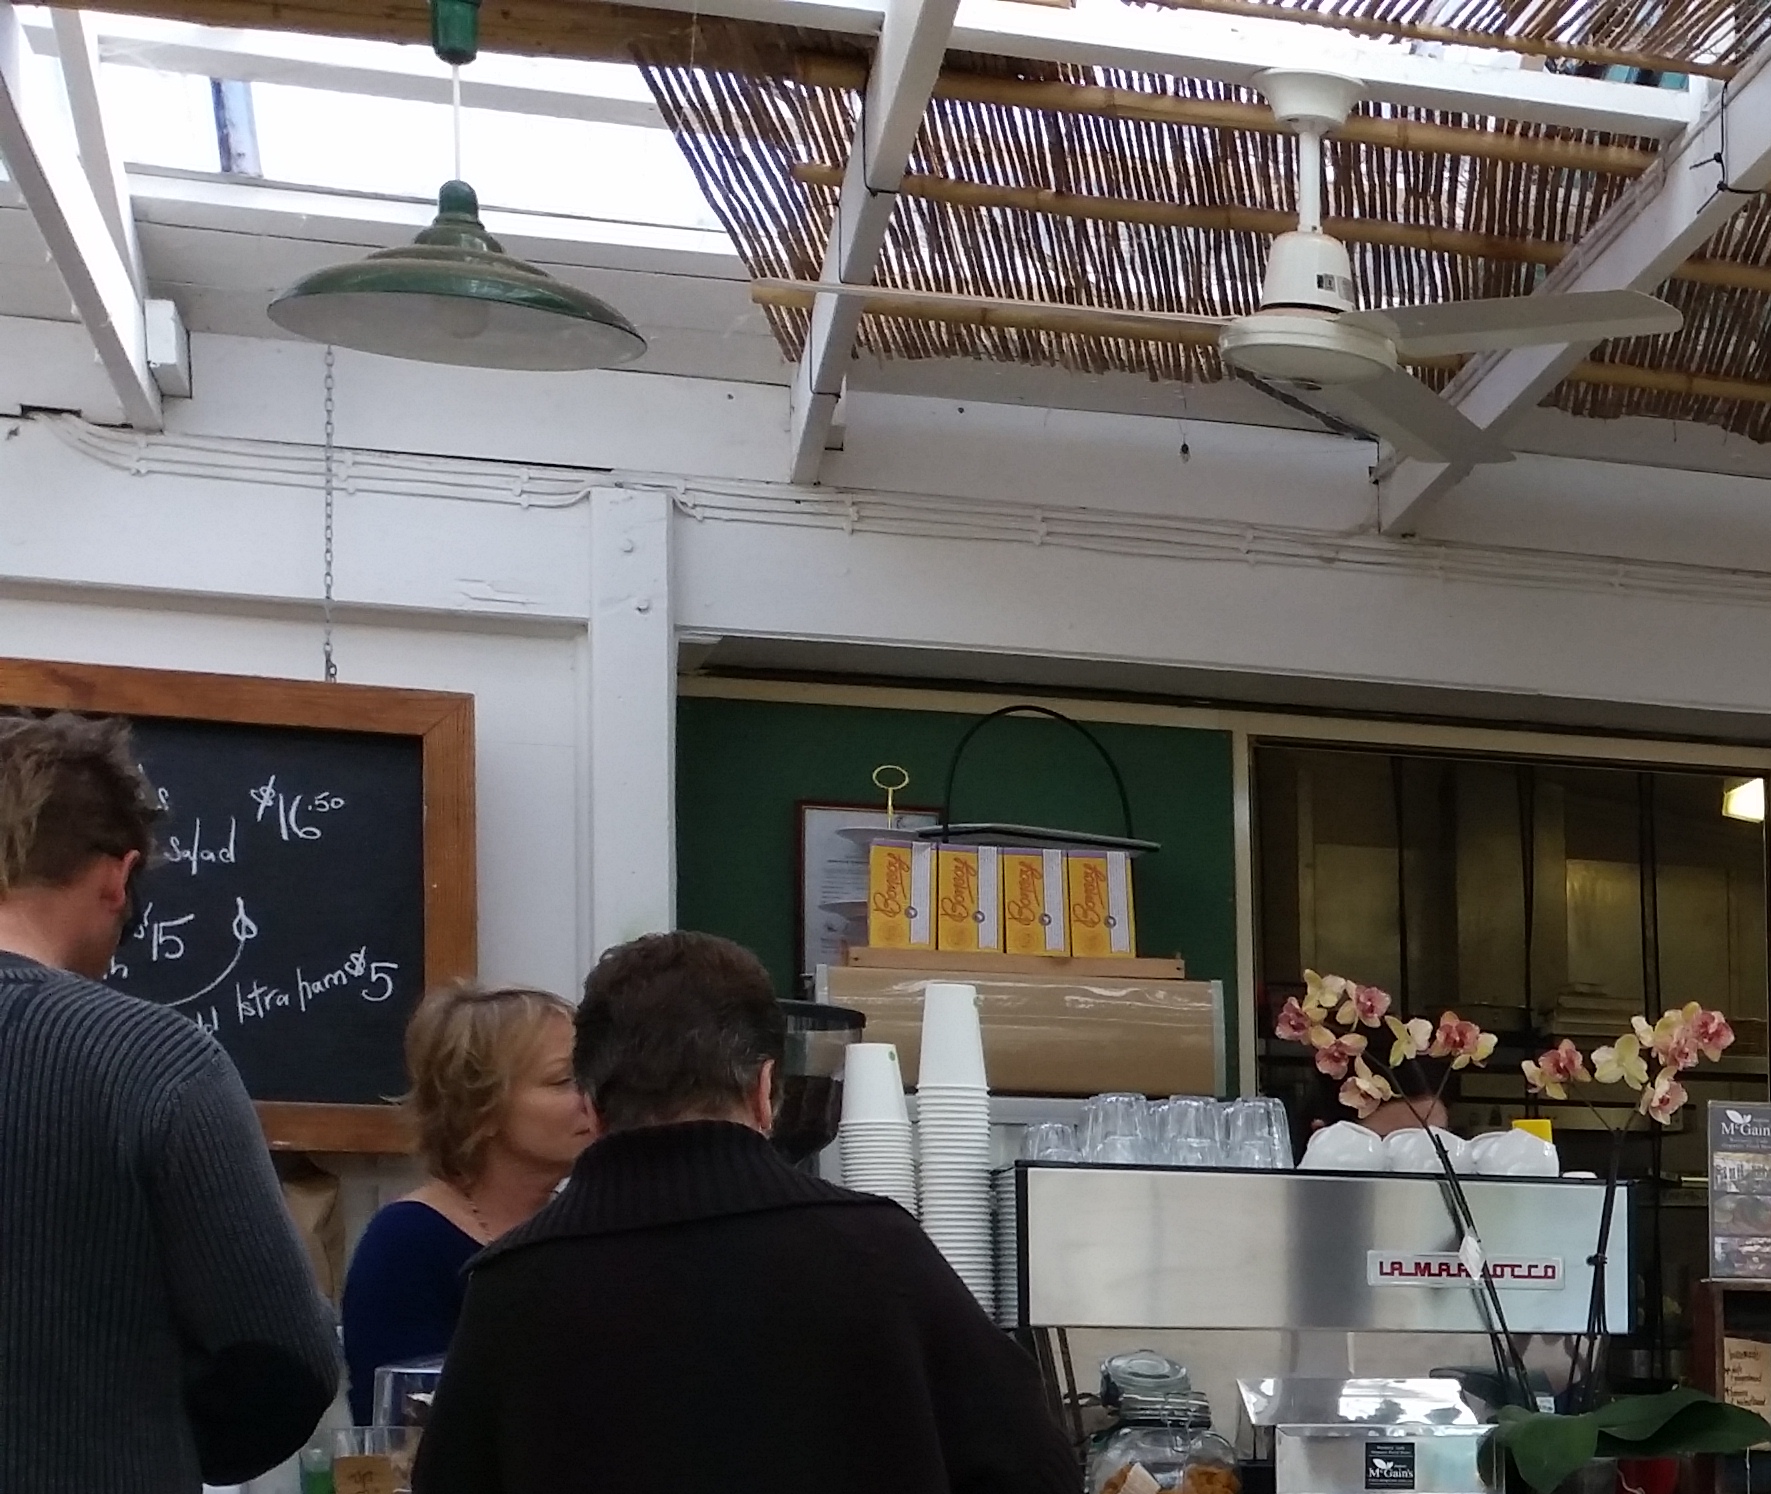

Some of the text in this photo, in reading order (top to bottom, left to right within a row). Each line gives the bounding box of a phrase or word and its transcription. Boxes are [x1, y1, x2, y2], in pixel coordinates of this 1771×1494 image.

[873, 852, 910, 918] Bonsoy
[940, 857, 977, 923] Bonsoy
[1007, 861, 1043, 926] Bonsoy
[1073, 863, 1106, 929] Bonsoy
